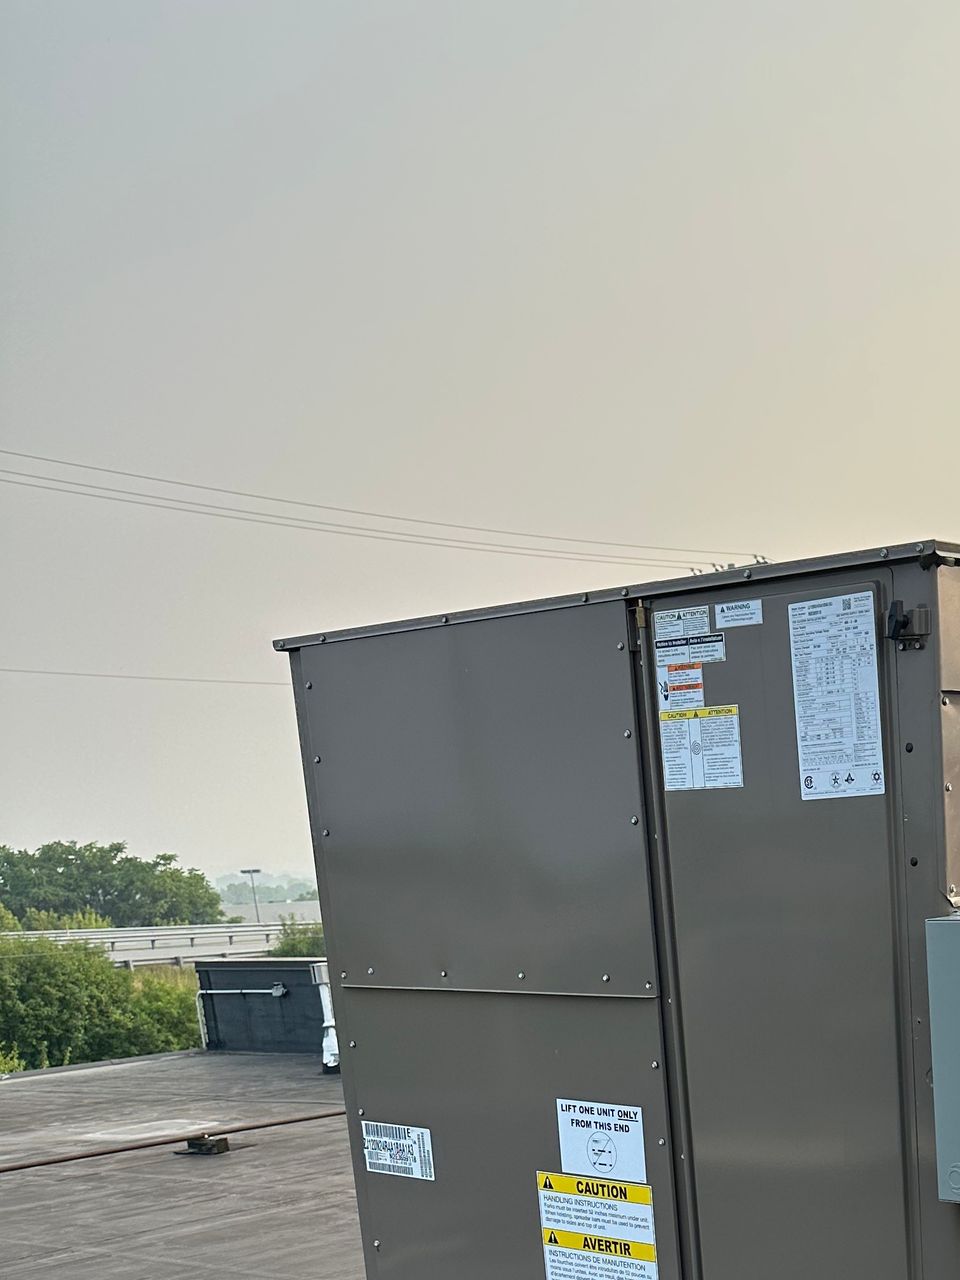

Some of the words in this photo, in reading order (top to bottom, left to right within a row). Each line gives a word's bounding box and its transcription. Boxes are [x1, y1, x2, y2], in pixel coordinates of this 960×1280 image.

[682, 610, 707, 618] ATTENTION
[561, 1104, 577, 1113] LIFT
[579, 1106, 595, 1115] ONE
[597, 1108, 615, 1117] UNIT
[617, 1110, 638, 1120] ONLY
[571, 1119, 592, 1129] FROM
[594, 1121, 612, 1131] THIS
[614, 1124, 630, 1133] END
[576, 1181, 628, 1200] CAUTION
[544, 1195, 573, 1205] HANDLING
[574, 1199, 618, 1211] INSTRUCTIONS
[583, 1236, 631, 1256] AVERTIR
[549, 1250, 592, 1263] INSTRUCTIONS
[602, 1258, 645, 1271] MANUTENTION
